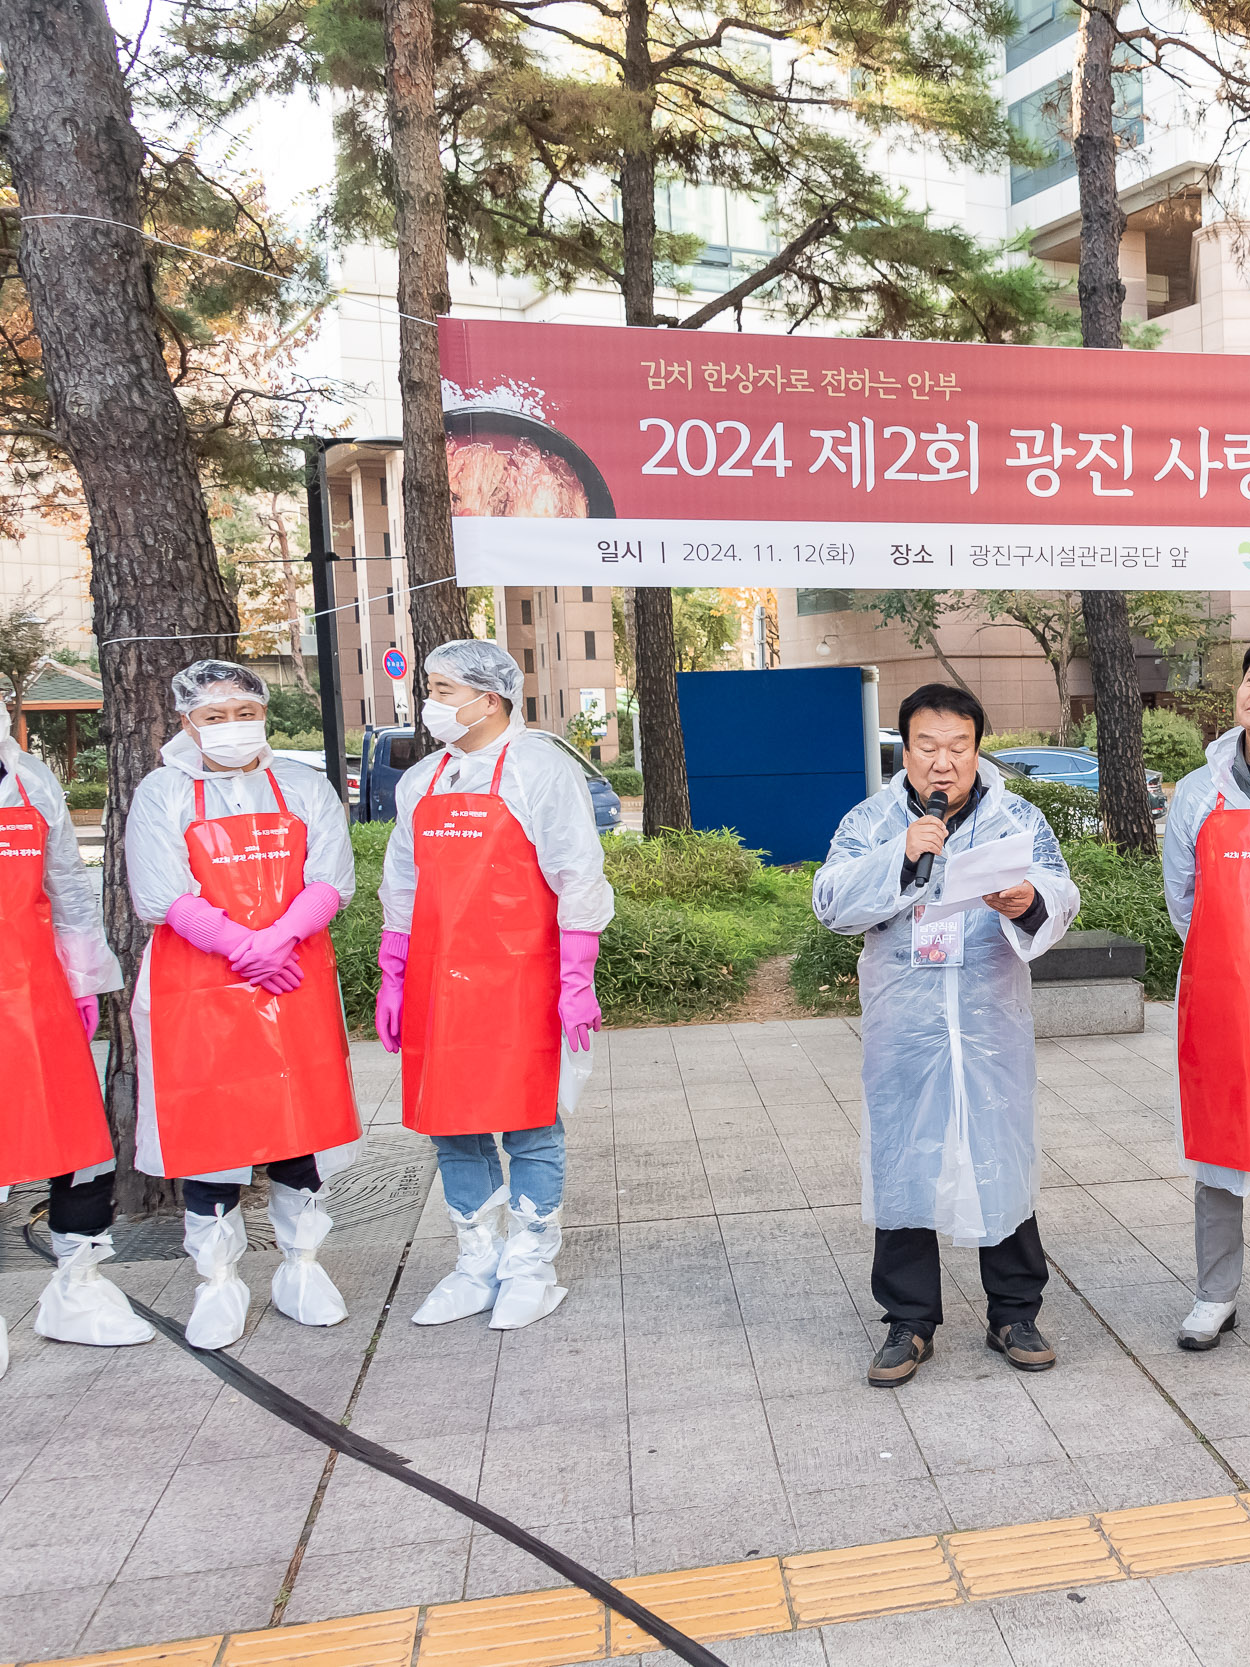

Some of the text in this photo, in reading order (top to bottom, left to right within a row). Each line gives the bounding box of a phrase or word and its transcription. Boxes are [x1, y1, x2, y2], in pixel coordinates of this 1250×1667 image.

[640, 359, 962, 401] 김치 한상자로 전하는 안부
[639, 417, 793, 478] 2024
[808, 416, 979, 495] 제2회
[1005, 422, 1134, 498] 광진
[597, 540, 855, 565] 일시 2024. 11. 12(화)
[890, 543, 1190, 568] 장소 광진구시설관리공단 앞
[920, 934, 956, 945] STAFF
